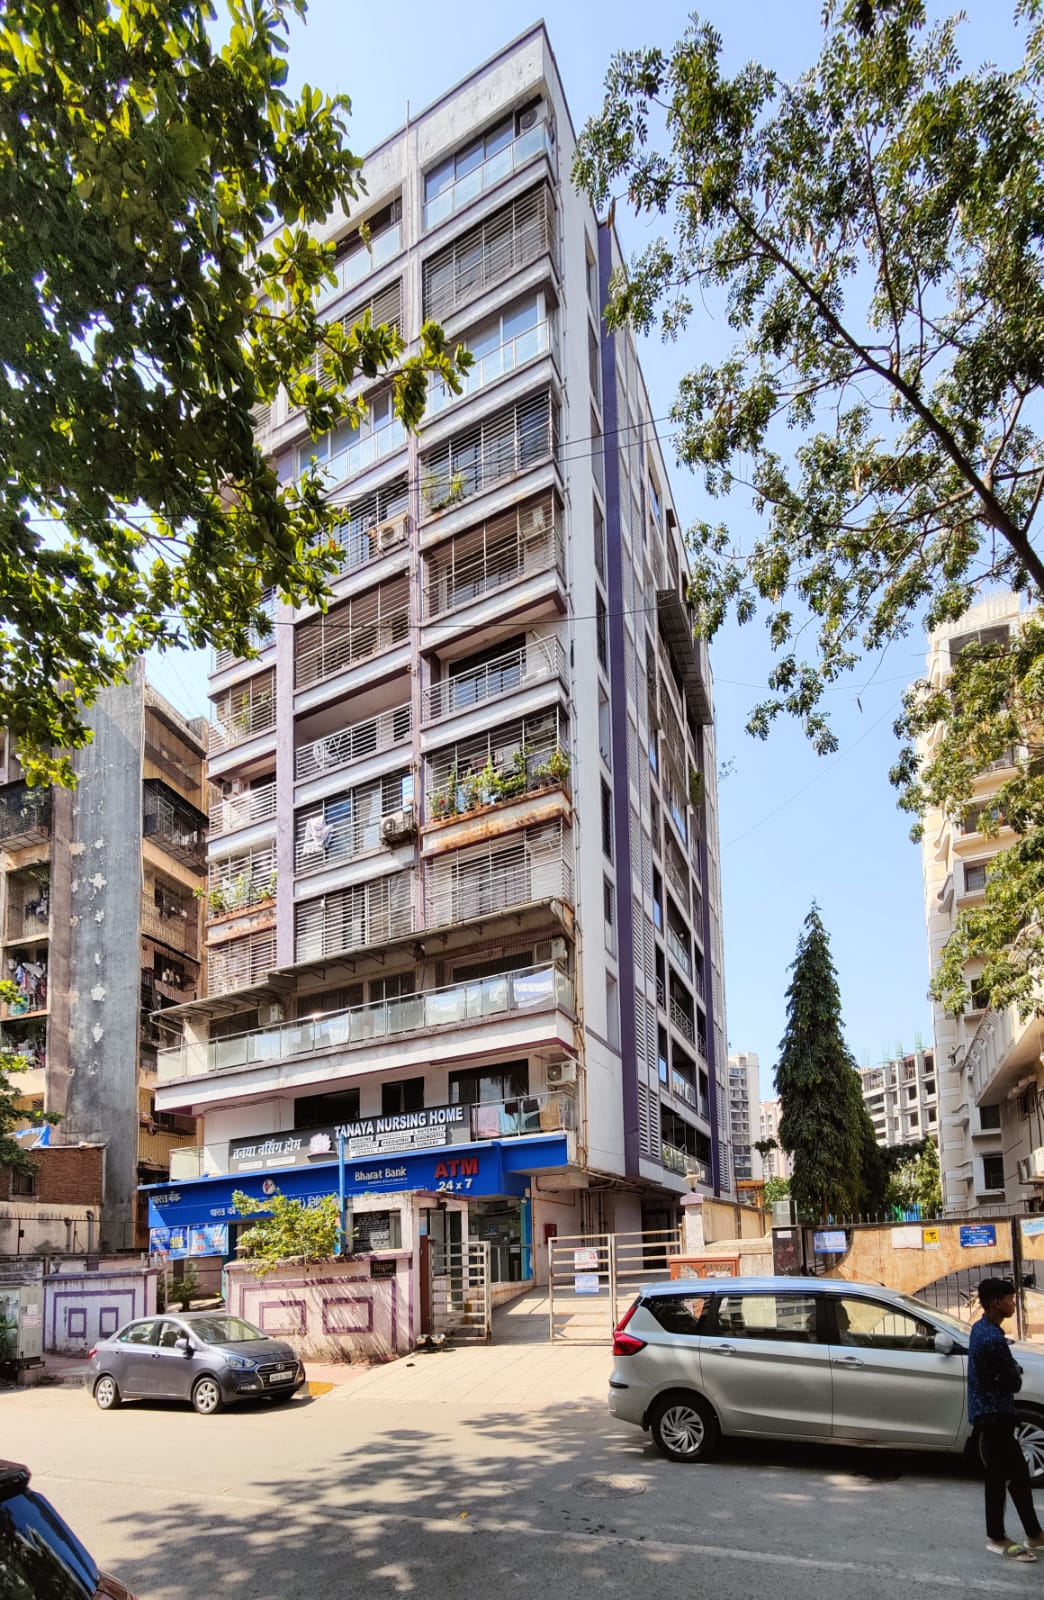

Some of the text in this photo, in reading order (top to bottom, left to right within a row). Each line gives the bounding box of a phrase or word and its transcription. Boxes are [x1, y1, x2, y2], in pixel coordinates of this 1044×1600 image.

[334, 1107, 463, 1138] TANAYA NURSING HOME
[415, 1132, 444, 1141] DIAGNOSTIC
[416, 1126, 445, 1135] MATERNITY
[232, 1137, 302, 1160] तनया नर्सिंग होम
[350, 1141, 378, 1150] INFERTILITY
[354, 1166, 407, 1181] Bharat Bank
[434, 1157, 478, 1179] ATM
[438, 1180, 454, 1191] 24
[464, 1178, 473, 1189] 7
